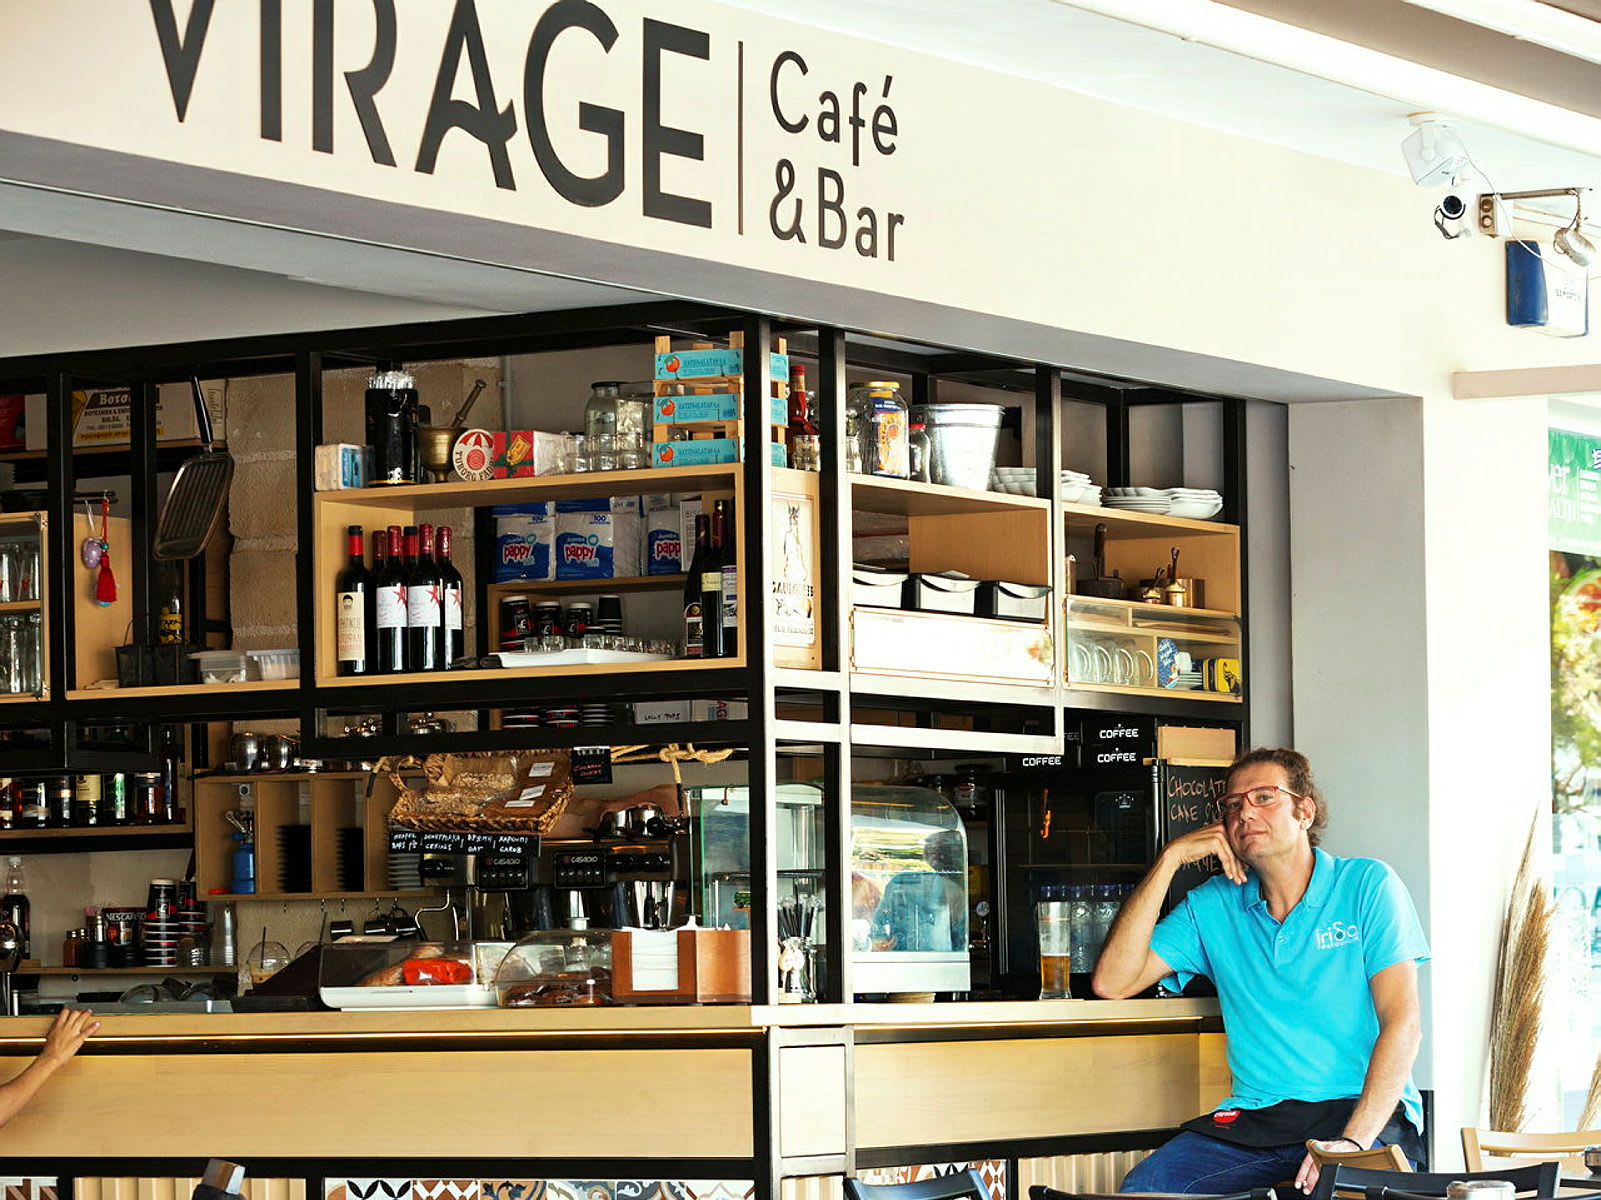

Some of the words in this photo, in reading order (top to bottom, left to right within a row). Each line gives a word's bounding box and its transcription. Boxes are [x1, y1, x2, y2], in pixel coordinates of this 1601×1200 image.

[150, 0, 712, 229] VIRAGE
[769, 50, 899, 167] Café
[768, 157, 906, 263] &Bar
[455, 450, 477, 481] TUBORG
[565, 545, 595, 562] pappy
[656, 541, 680, 558] papp
[1099, 728, 1139, 739] COFFEE
[1022, 756, 1062, 767] COFFEE
[1097, 752, 1137, 763] COFFEE
[1170, 803, 1198, 824] CAKE
